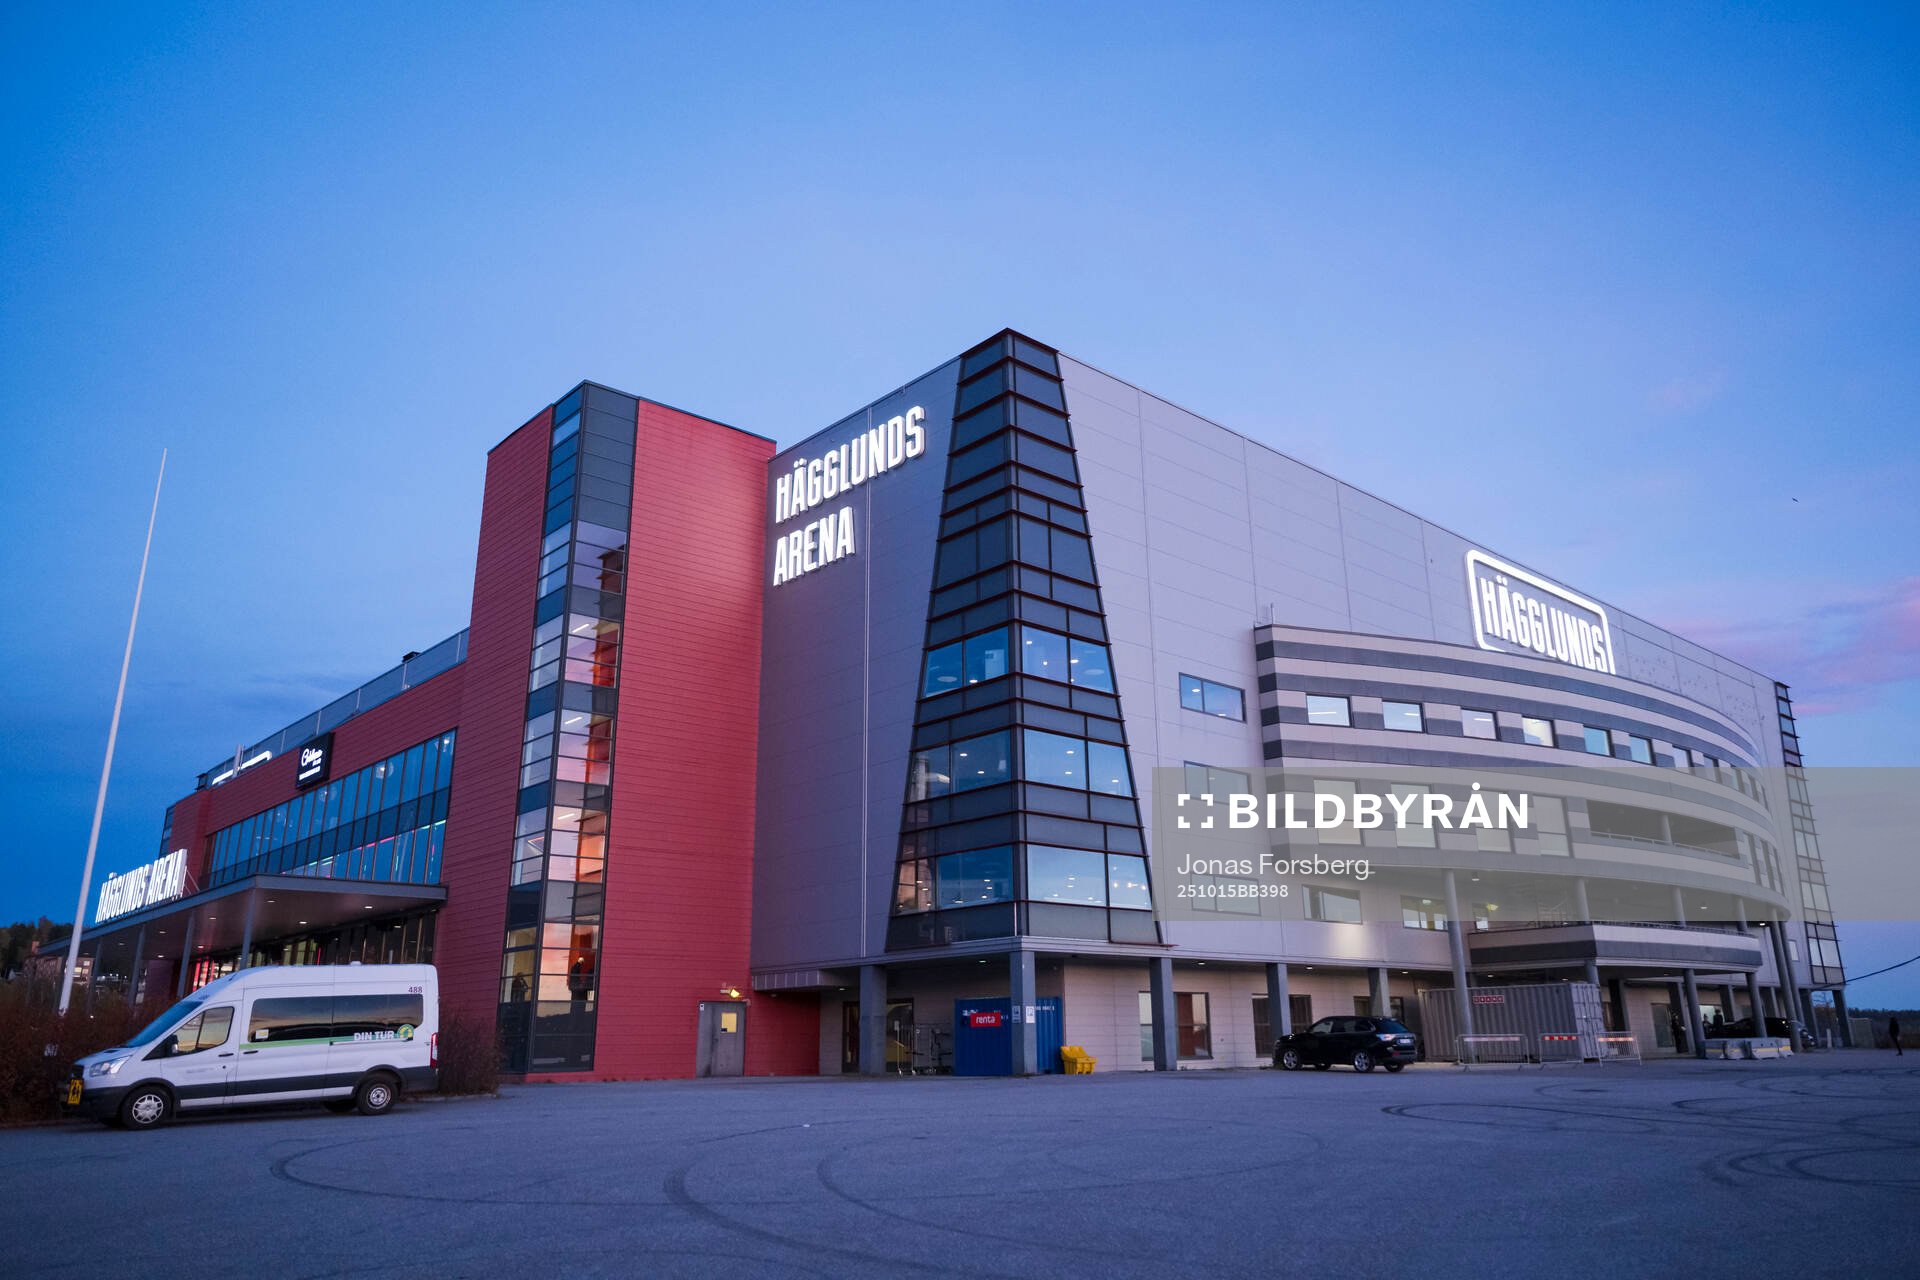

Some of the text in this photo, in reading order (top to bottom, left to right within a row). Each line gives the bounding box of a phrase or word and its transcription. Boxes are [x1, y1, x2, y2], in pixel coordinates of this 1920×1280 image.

[776, 406, 925, 523] HÄGGLUNDS
[773, 506, 855, 586] ARENA
[1480, 575, 1608, 673] HÄGGLUNDS
[95, 848, 187, 924] HÄGGLUNDS ARENA
[408, 986, 423, 994] 488
[975, 1015, 995, 1024] renta
[354, 1031, 394, 1041] DIN TUR
